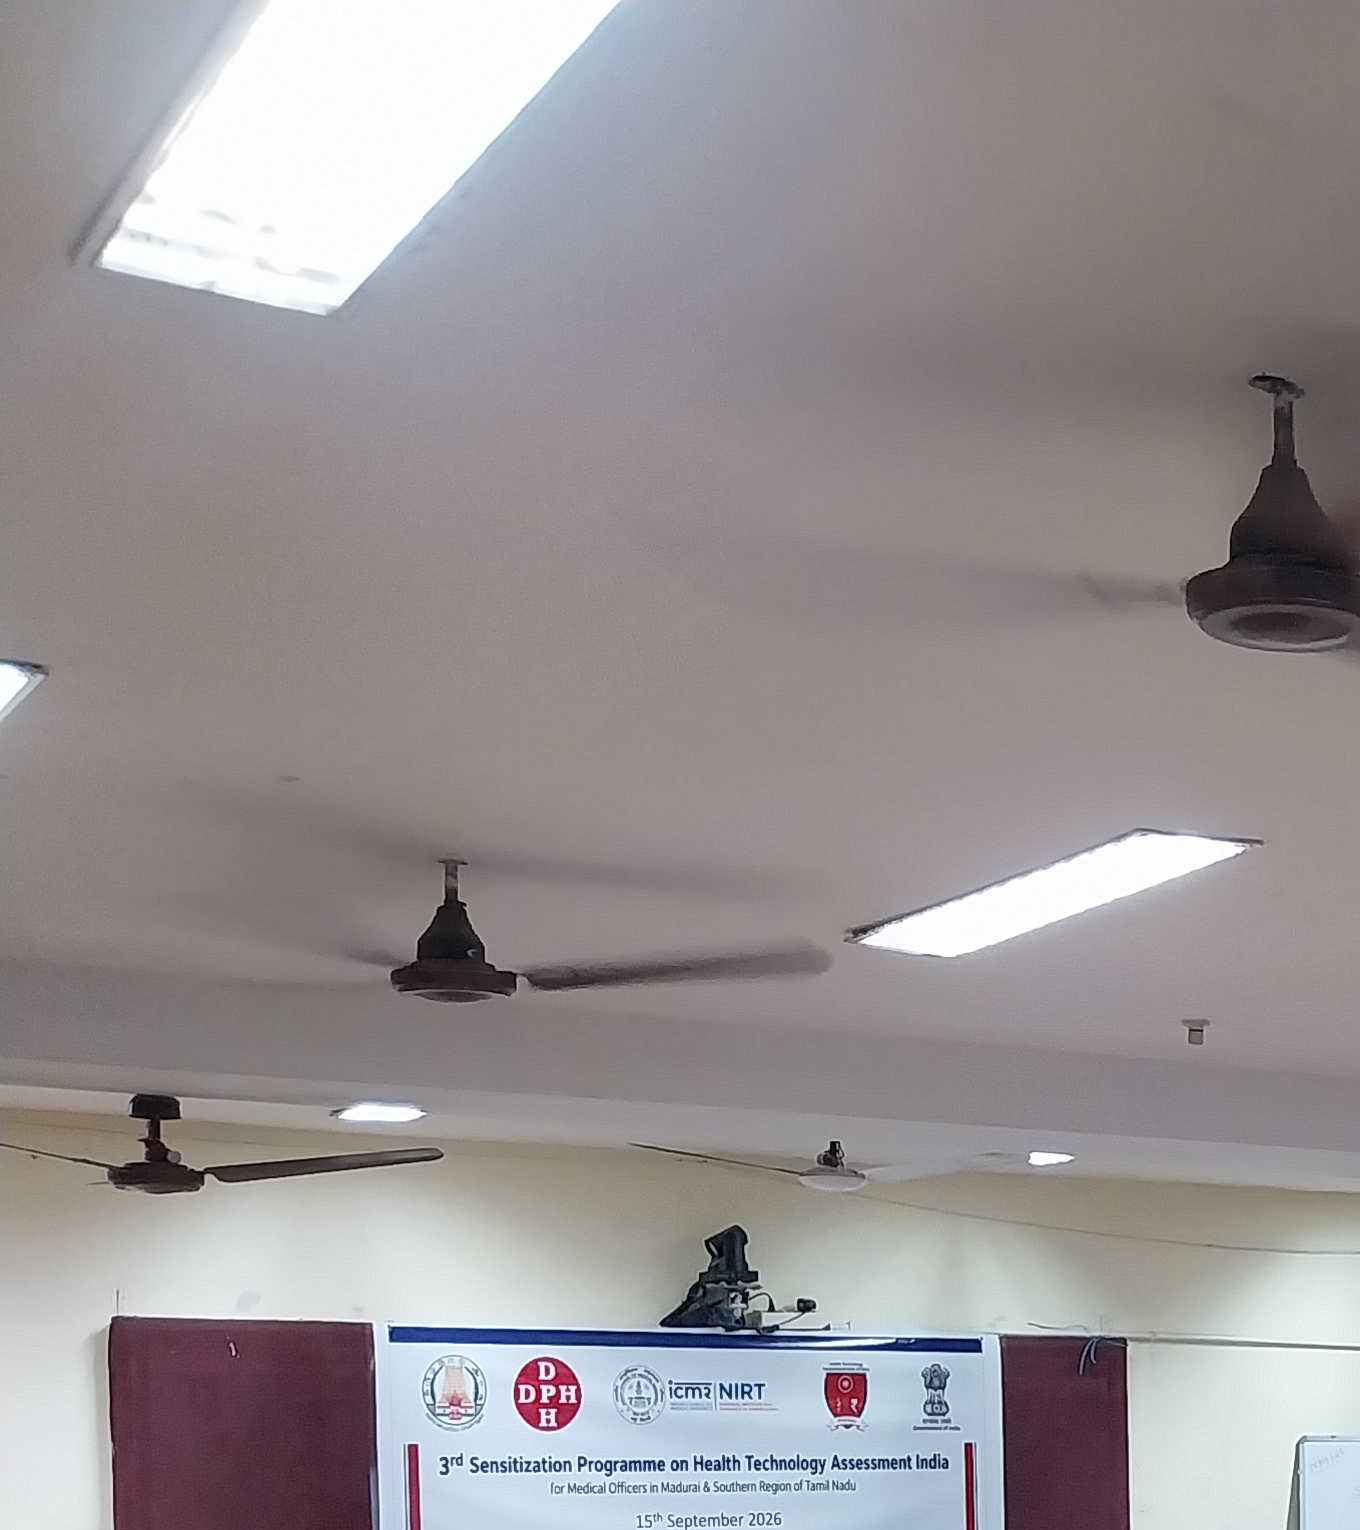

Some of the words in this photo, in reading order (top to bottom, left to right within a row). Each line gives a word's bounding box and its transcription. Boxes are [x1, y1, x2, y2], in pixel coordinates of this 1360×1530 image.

[517, 1384, 578, 1404] DPH
[719, 1382, 766, 1401] NIRT
[439, 1453, 463, 1475] 3rd
[470, 1456, 572, 1473] Sensitization
[577, 1456, 665, 1476] Programme
[671, 1459, 688, 1472] on
[694, 1455, 741, 1471] Health
[745, 1454, 826, 1475] Technology
[831, 1455, 912, 1470] Assessment
[916, 1454, 949, 1470] India
[551, 1482, 565, 1494] for
[568, 1483, 606, 1494] Medical
[609, 1482, 647, 1493] Officers
[649, 1481, 659, 1493] in
[661, 1480, 701, 1493] Madurai
[703, 1482, 710, 1492] &
[713, 1481, 756, 1492] Southern
[759, 1480, 792, 1495] Region
[794, 1480, 803, 1491] of
[805, 1480, 829, 1491] Tamil
[832, 1479, 856, 1491] Nadu
[636, 1513, 663, 1528] 15th
[667, 1513, 744, 1530] September
[748, 1512, 782, 1526] 2026
